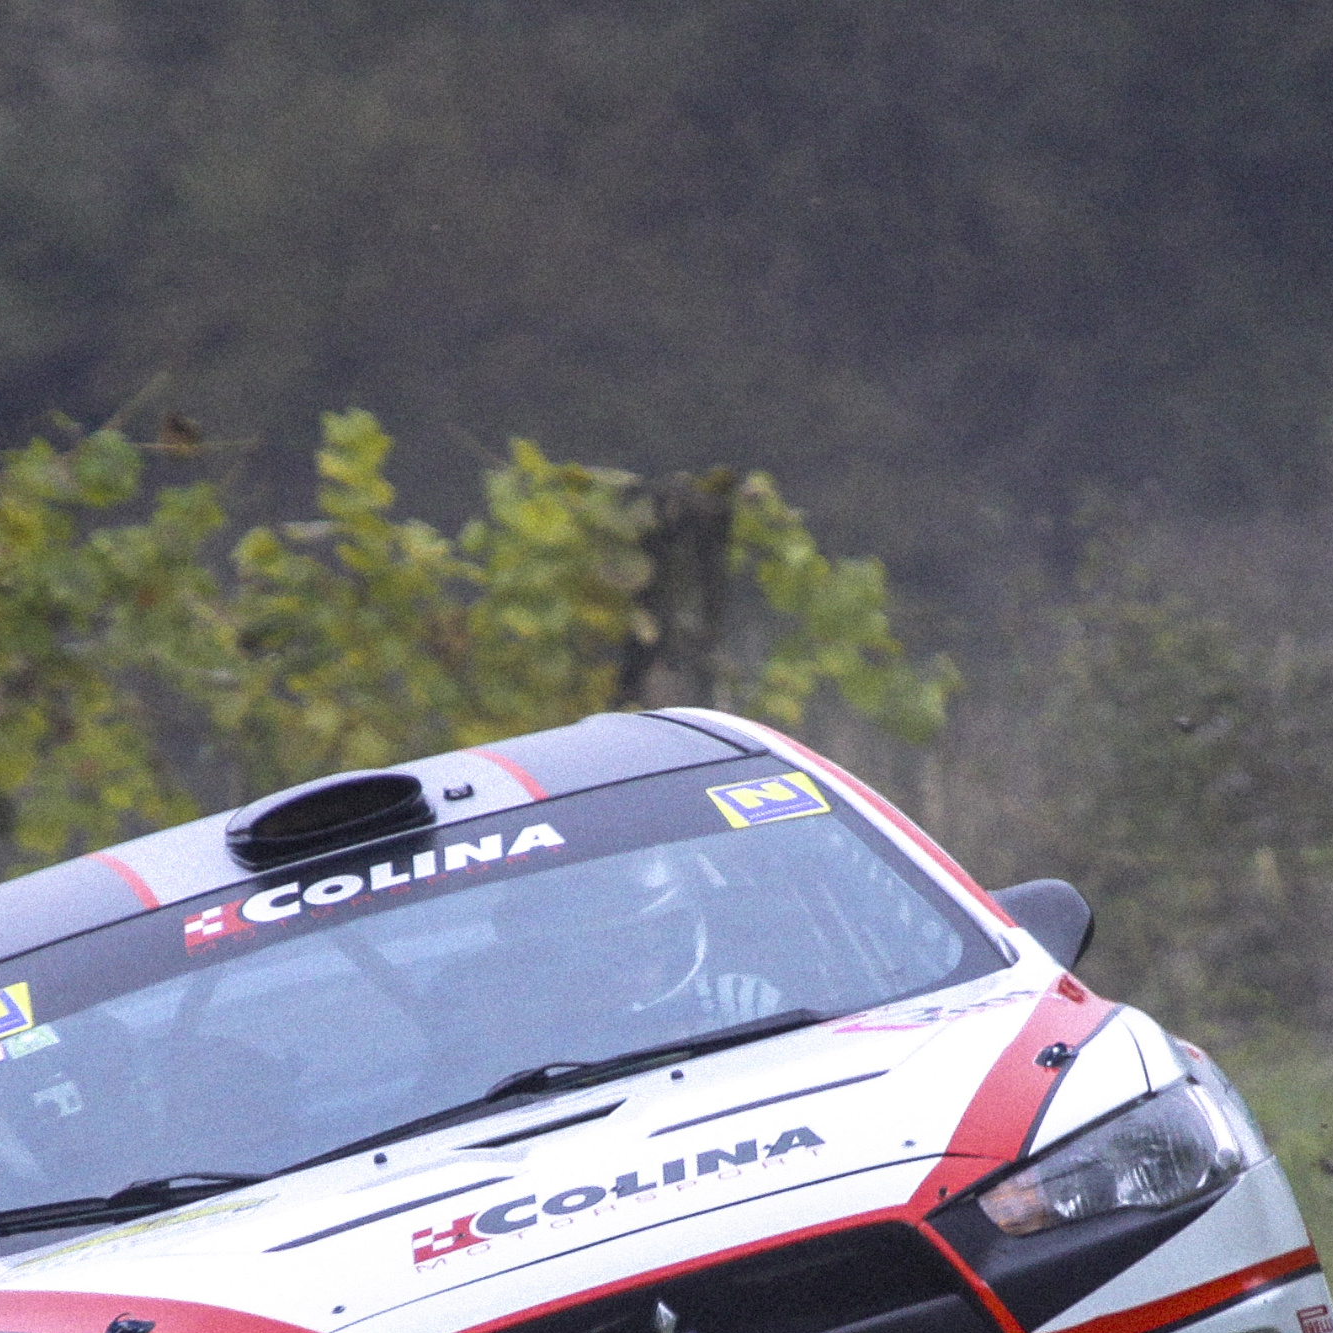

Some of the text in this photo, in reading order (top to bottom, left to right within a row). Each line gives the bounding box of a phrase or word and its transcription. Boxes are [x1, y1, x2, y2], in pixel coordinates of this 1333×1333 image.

[726, 782, 798, 810] N
[242, 823, 566, 922] COLINA
[415, 1147, 819, 1273] MOTORSPORT
[475, 1126, 826, 1235] COLINA
